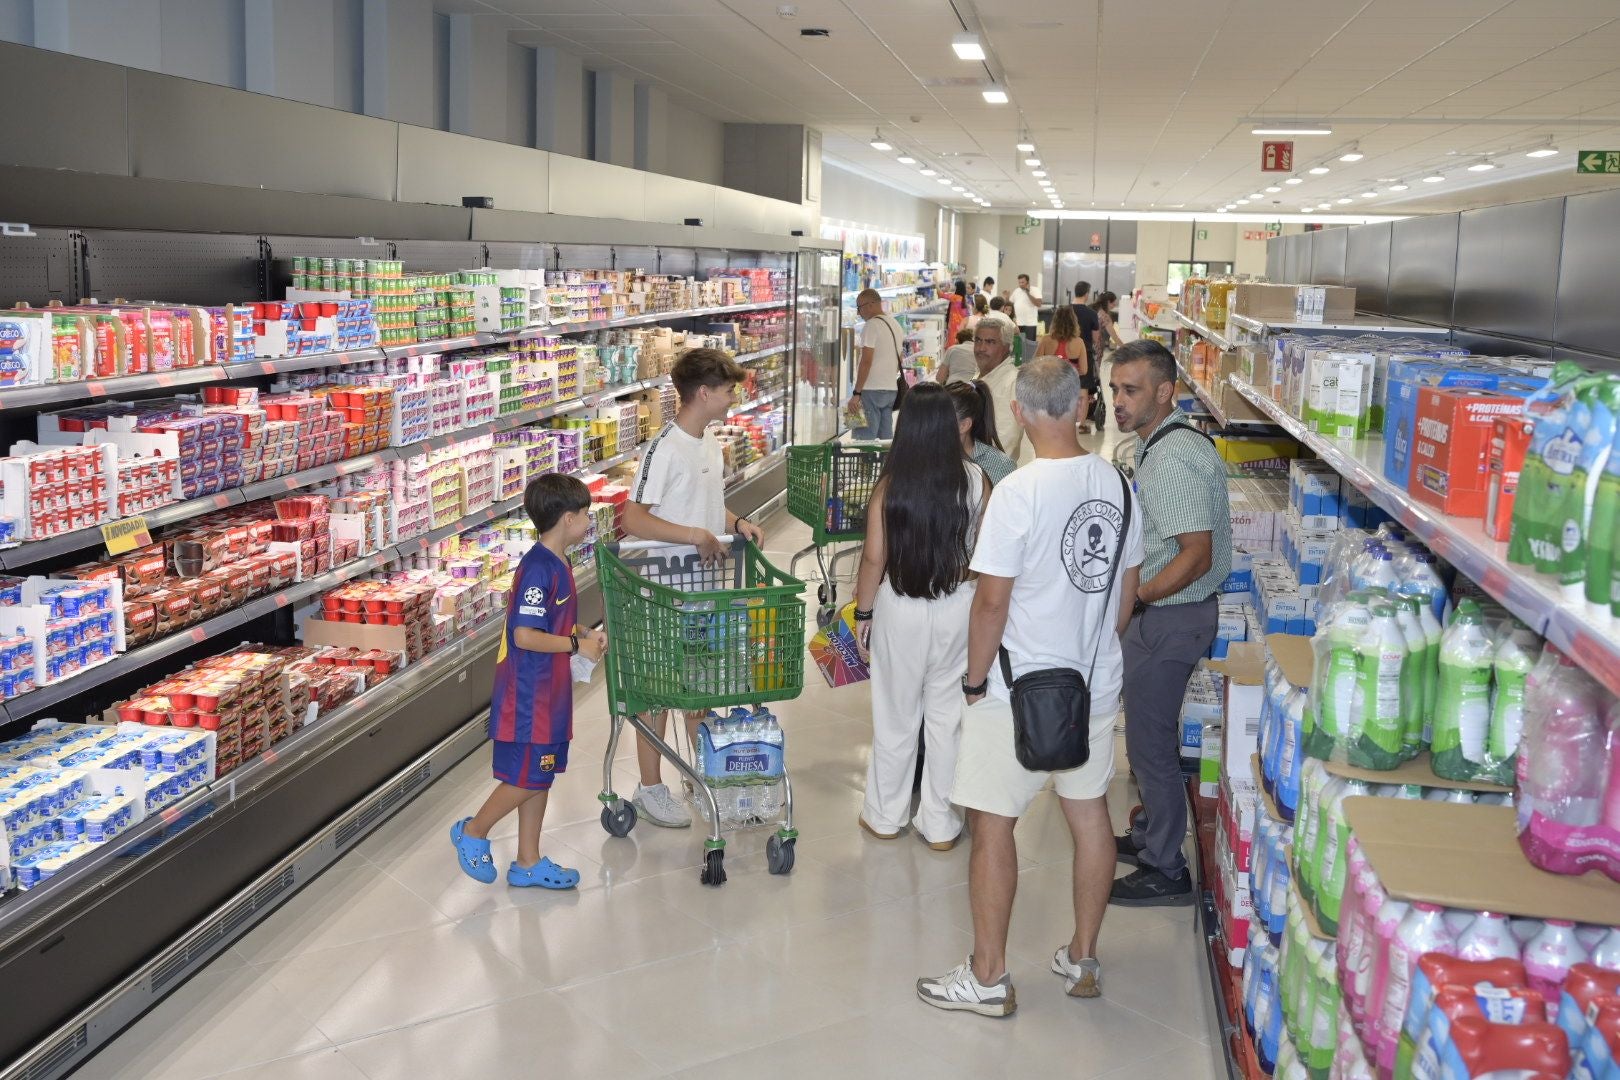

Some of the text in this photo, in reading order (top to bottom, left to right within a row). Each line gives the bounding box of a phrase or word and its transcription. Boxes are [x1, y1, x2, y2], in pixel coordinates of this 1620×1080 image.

[1465, 403, 1522, 415] +PROTEÍNAS
[1064, 502, 1122, 556] SCALPERS COMPAN
[1068, 562, 1106, 591] THE SKULL
[1224, 582, 1248, 590] ENTERA
[728, 760, 765, 771] DEHESA
